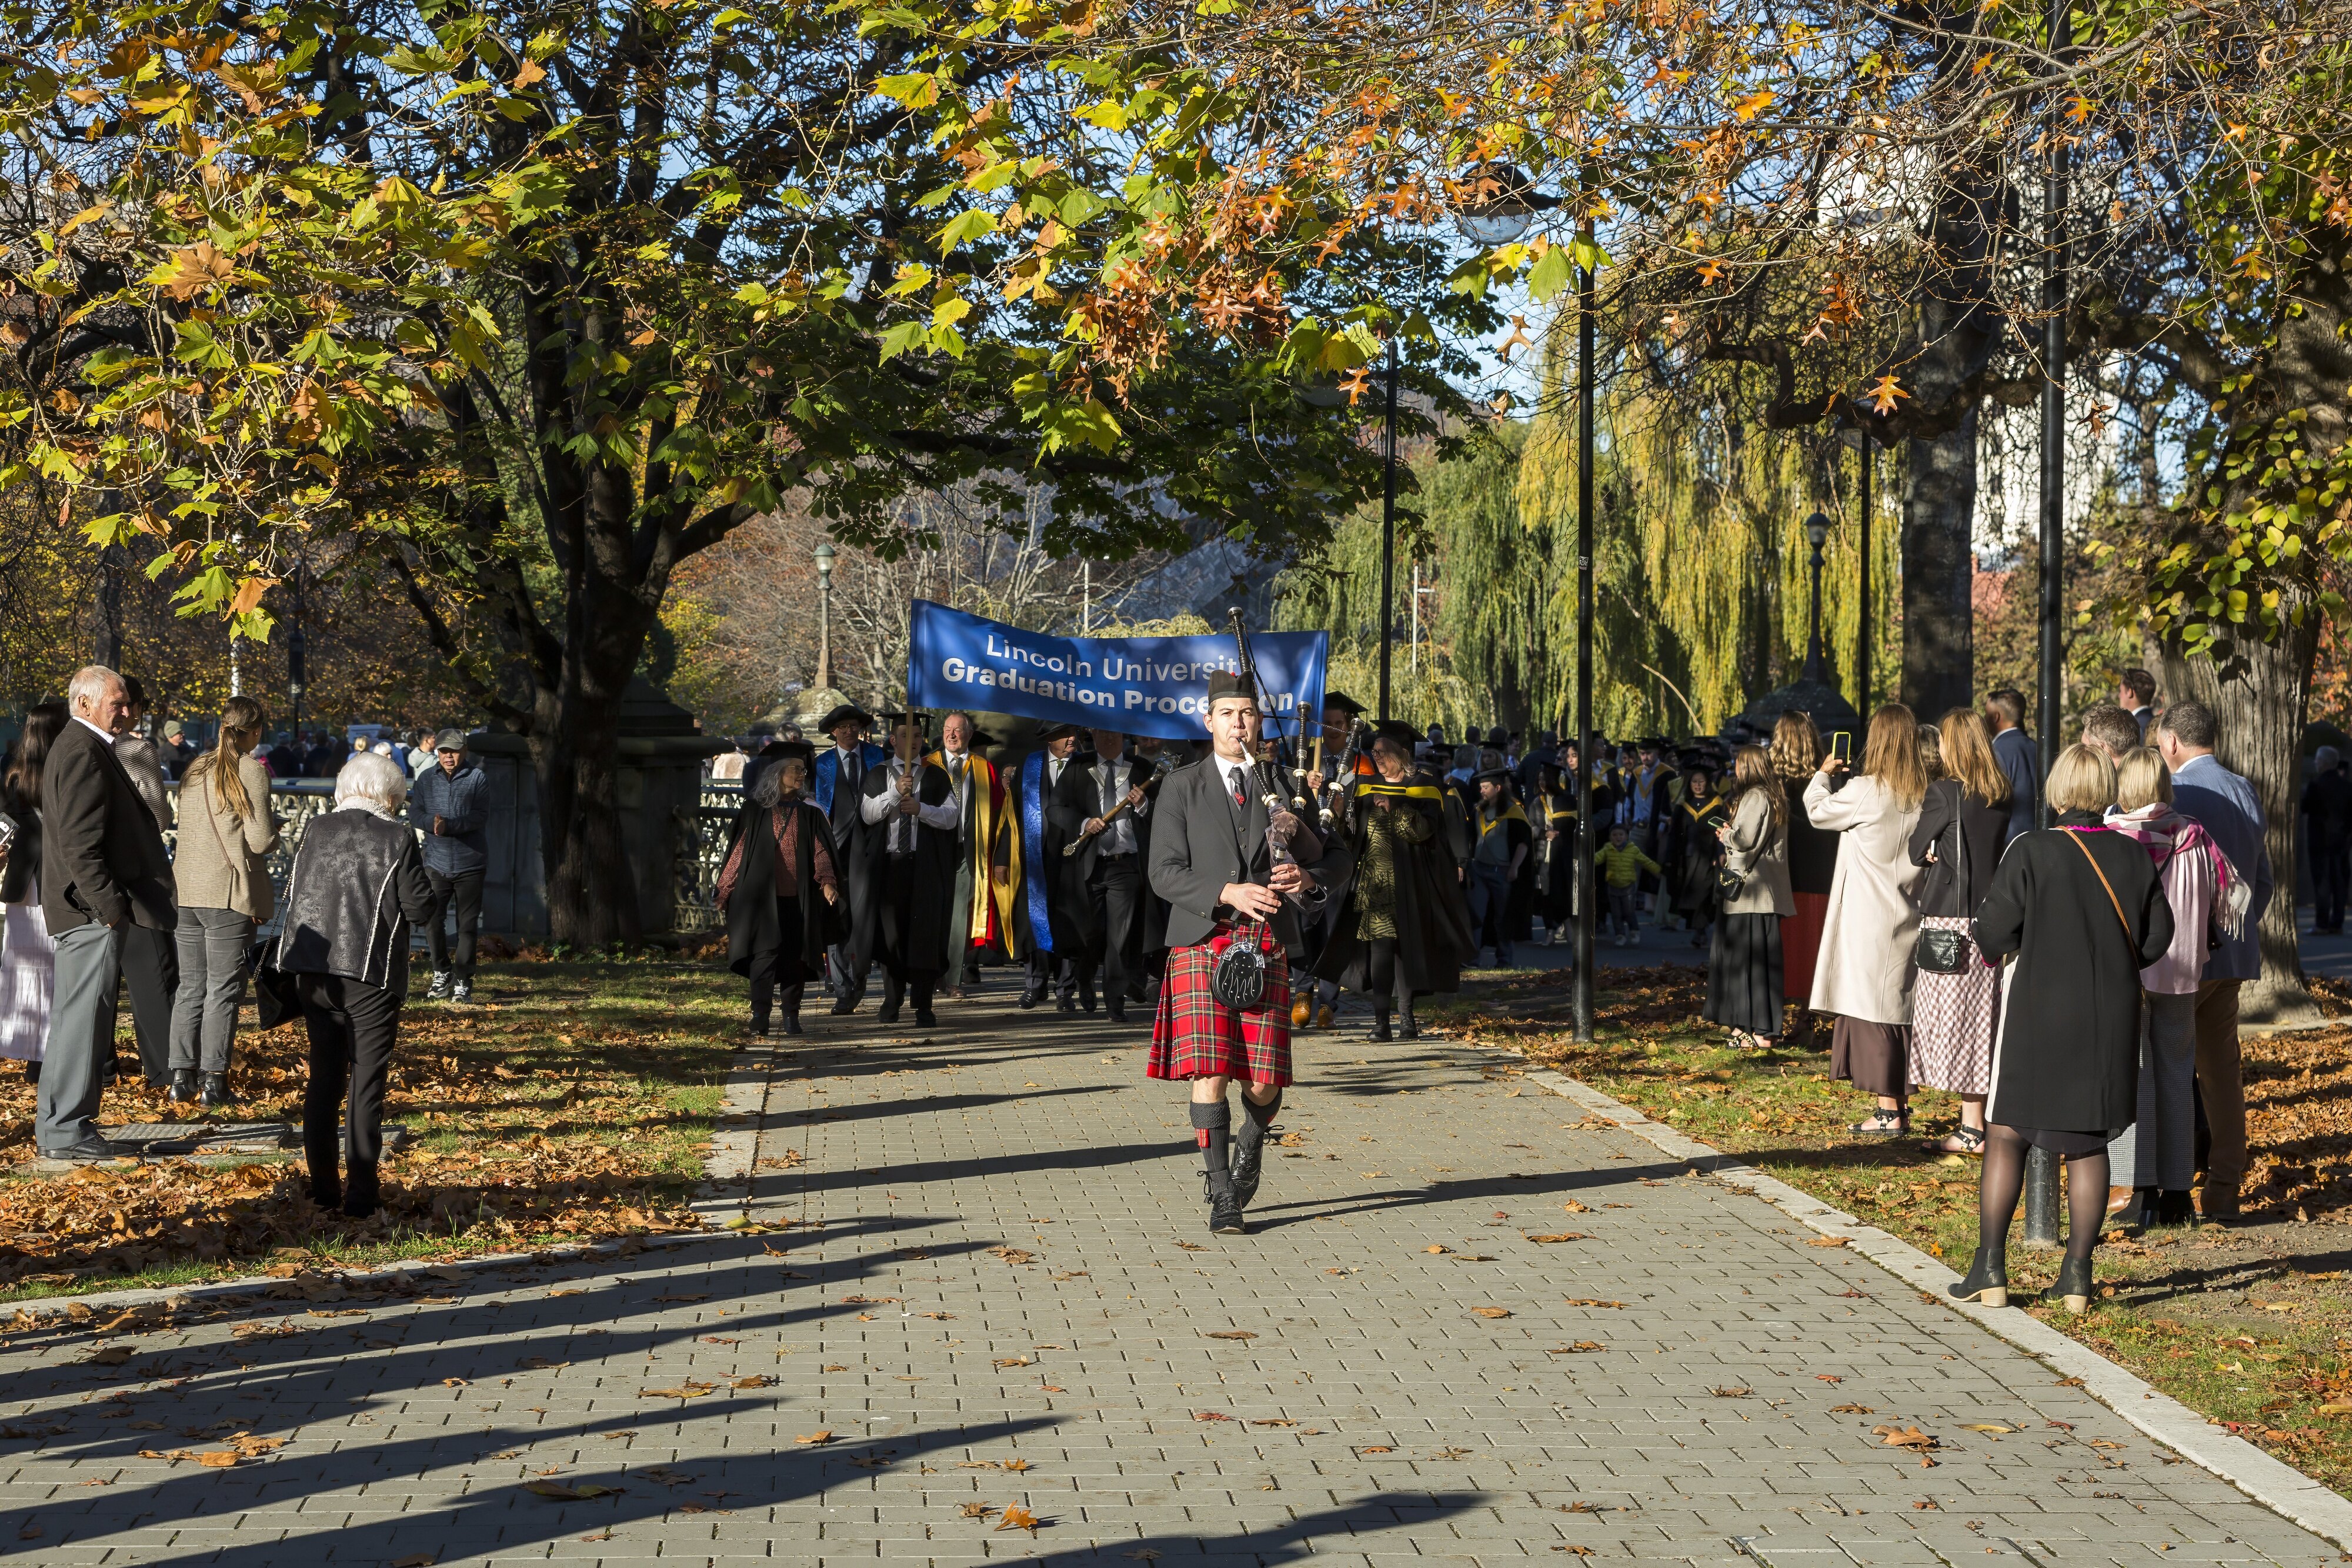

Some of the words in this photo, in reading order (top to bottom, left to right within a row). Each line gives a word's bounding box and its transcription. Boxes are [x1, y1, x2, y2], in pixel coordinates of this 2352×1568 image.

[987, 635, 1092, 678] Lincoln
[1103, 655, 1237, 682] Universit
[942, 658, 1115, 708] Graduation
[1125, 690, 1293, 715] Proceon
